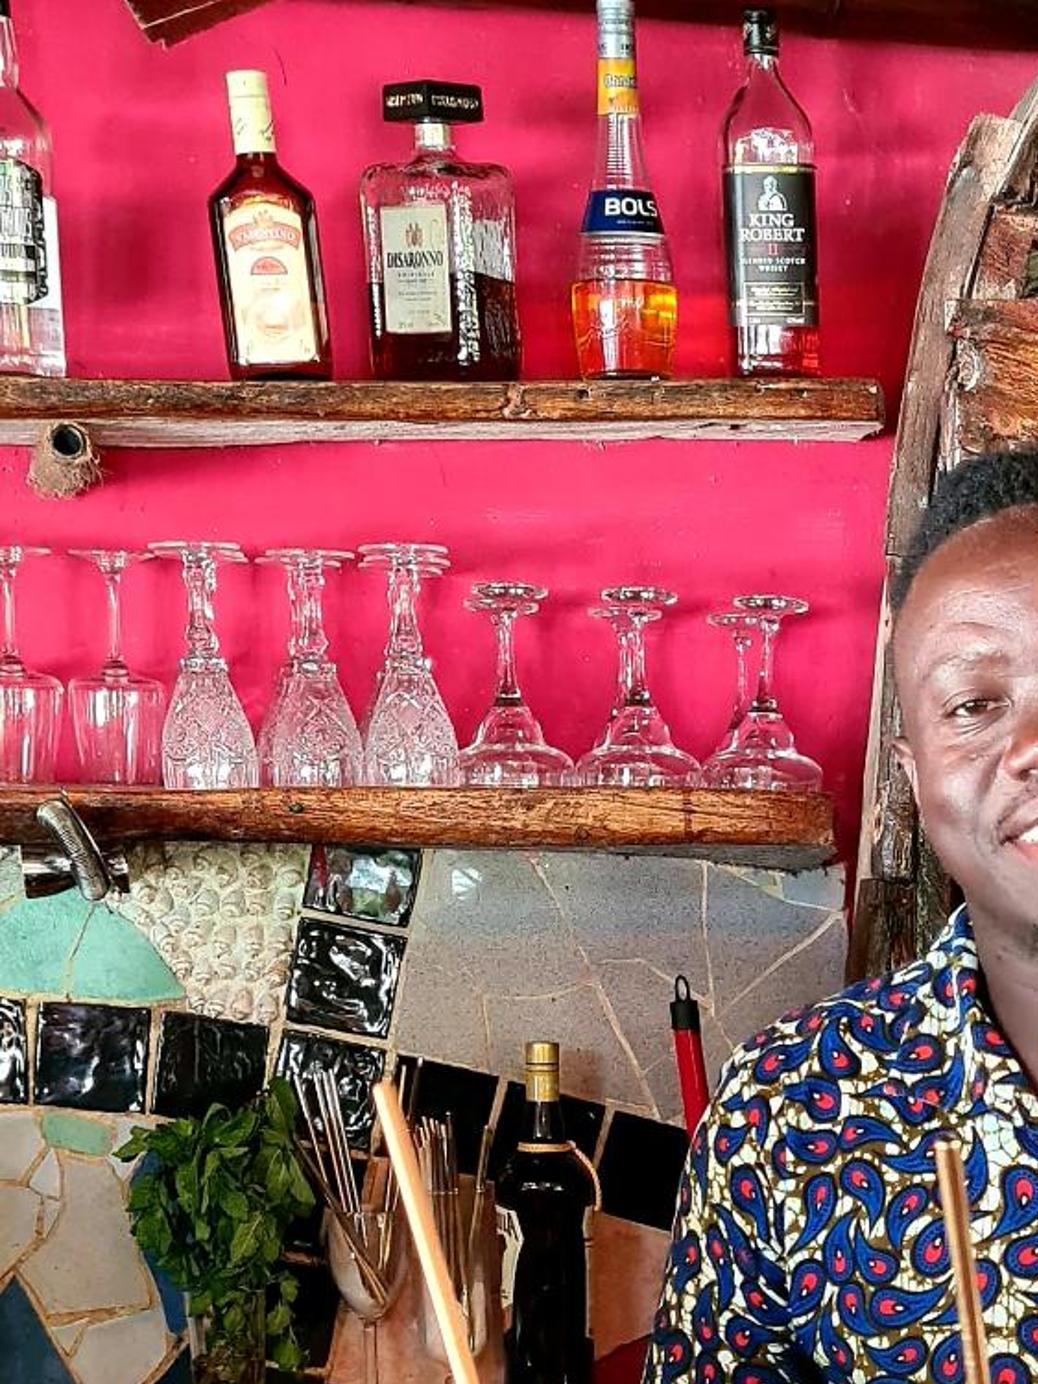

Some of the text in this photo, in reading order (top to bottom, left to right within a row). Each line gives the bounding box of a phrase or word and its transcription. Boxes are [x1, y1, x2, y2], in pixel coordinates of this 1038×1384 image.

[605, 198, 658, 217] BOLS
[749, 213, 794, 227] KING
[740, 228, 805, 242] ROBERT
[387, 249, 444, 270] DISARONNO
